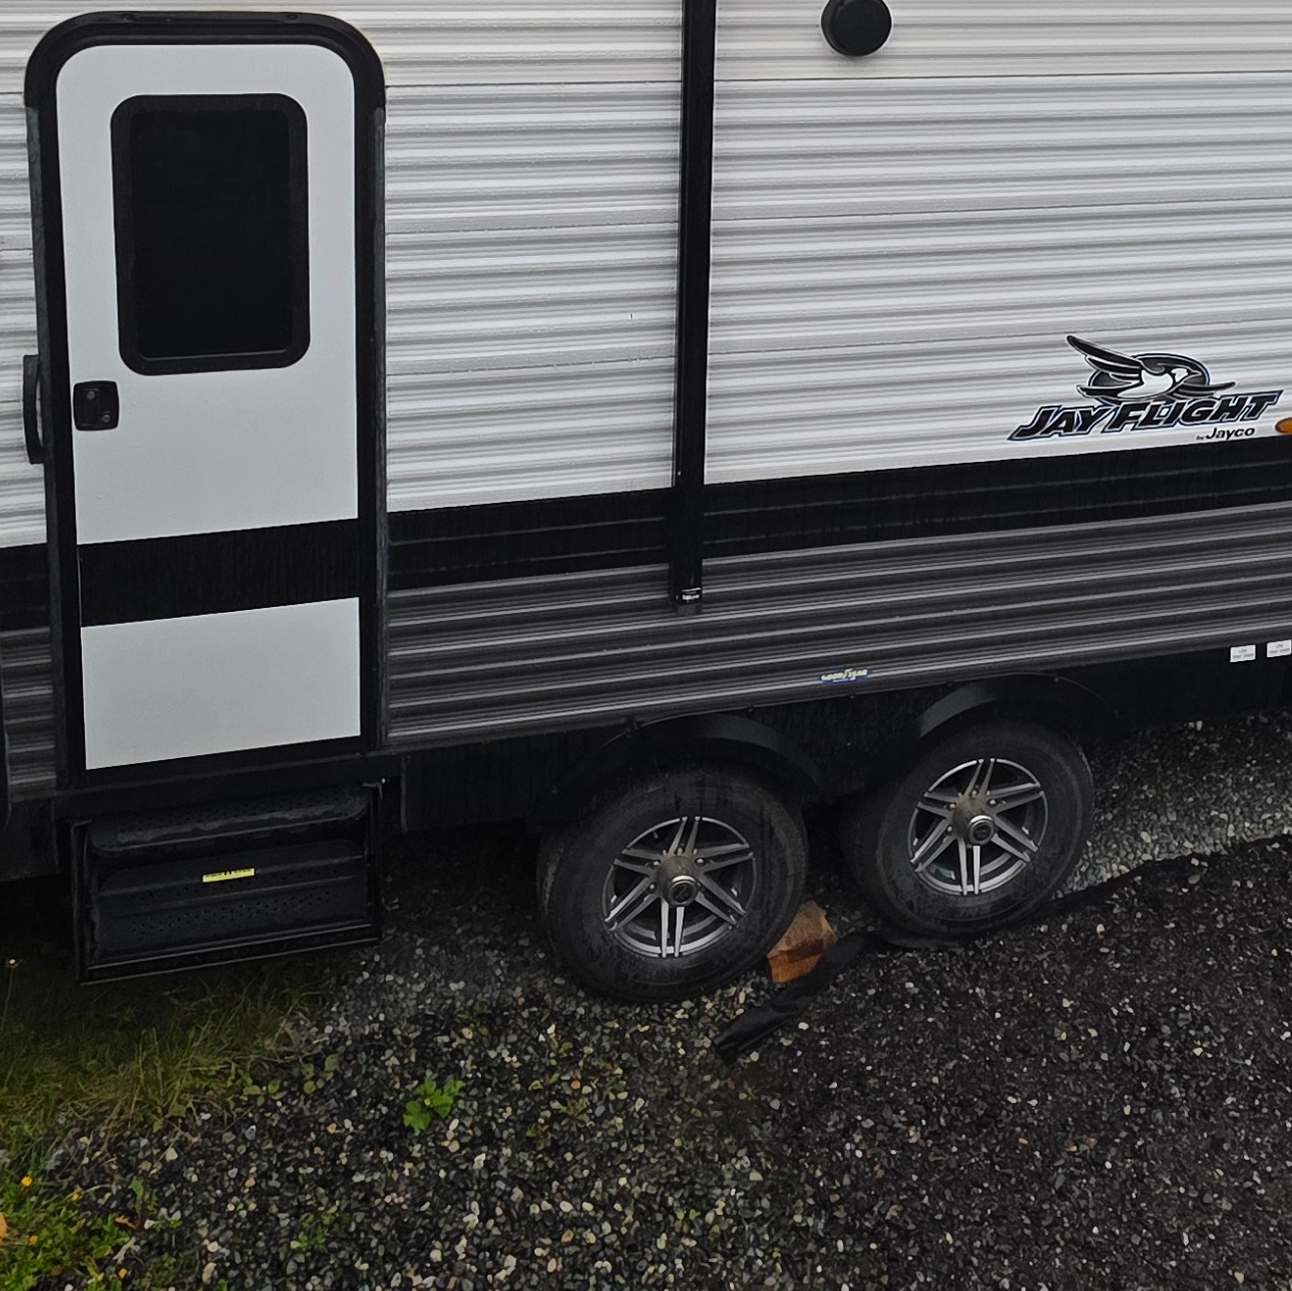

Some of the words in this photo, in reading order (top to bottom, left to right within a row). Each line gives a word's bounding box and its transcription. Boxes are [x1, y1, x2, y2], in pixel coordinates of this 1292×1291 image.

[1007, 405, 1118, 441] JAY
[1101, 390, 1284, 433] FLIGHT
[1206, 427, 1255, 441] Jayco
